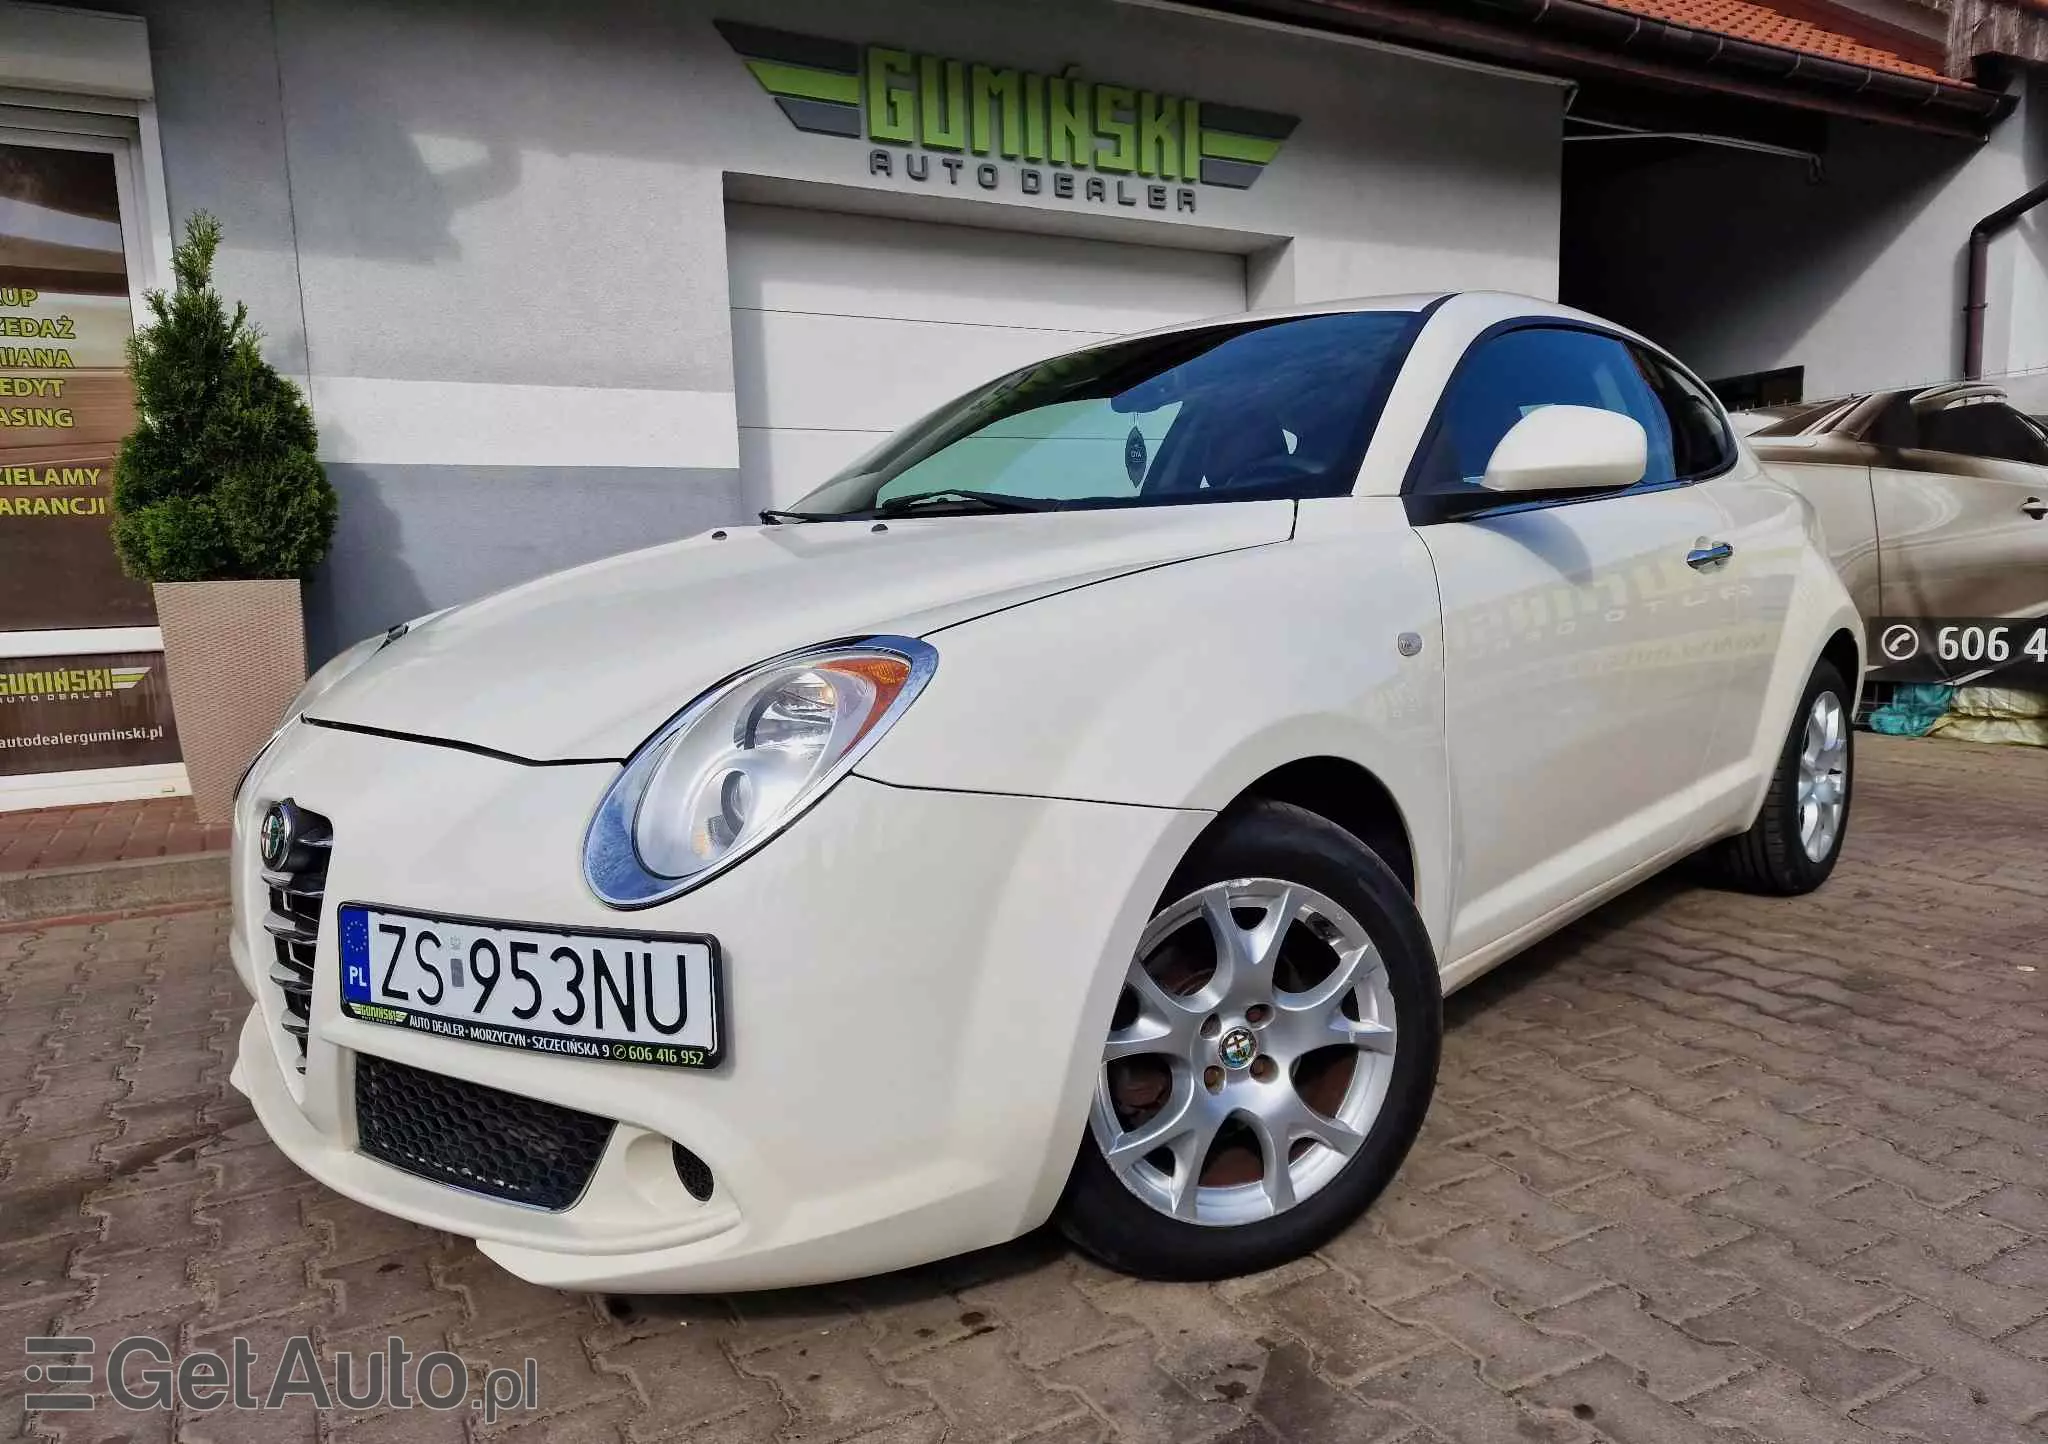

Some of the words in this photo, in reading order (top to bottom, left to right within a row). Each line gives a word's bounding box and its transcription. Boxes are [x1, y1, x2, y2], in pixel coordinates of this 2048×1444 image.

[867, 44, 1199, 184] GUMIŃSKI
[869, 149, 999, 190] AUTO
[1021, 168, 1197, 213] DEALER
[0, 287, 38, 307] UP
[1938, 626, 2010, 662] 606
[2023, 627, 2048, 663] 4
[349, 965, 367, 988] PL
[378, 923, 445, 1006] ZS
[469, 937, 688, 1035] 953NU
[409, 1014, 431, 1032] AUTO
[432, 1020, 465, 1038] DEALER
[470, 1026, 527, 1047] MORZYCZYN
[532, 1035, 599, 1057] SZCZECIŃSKA
[602, 1044, 610, 1057] 9
[628, 1046, 653, 1061] 606
[656, 1048, 677, 1063] 416
[680, 1050, 704, 1065] 952
